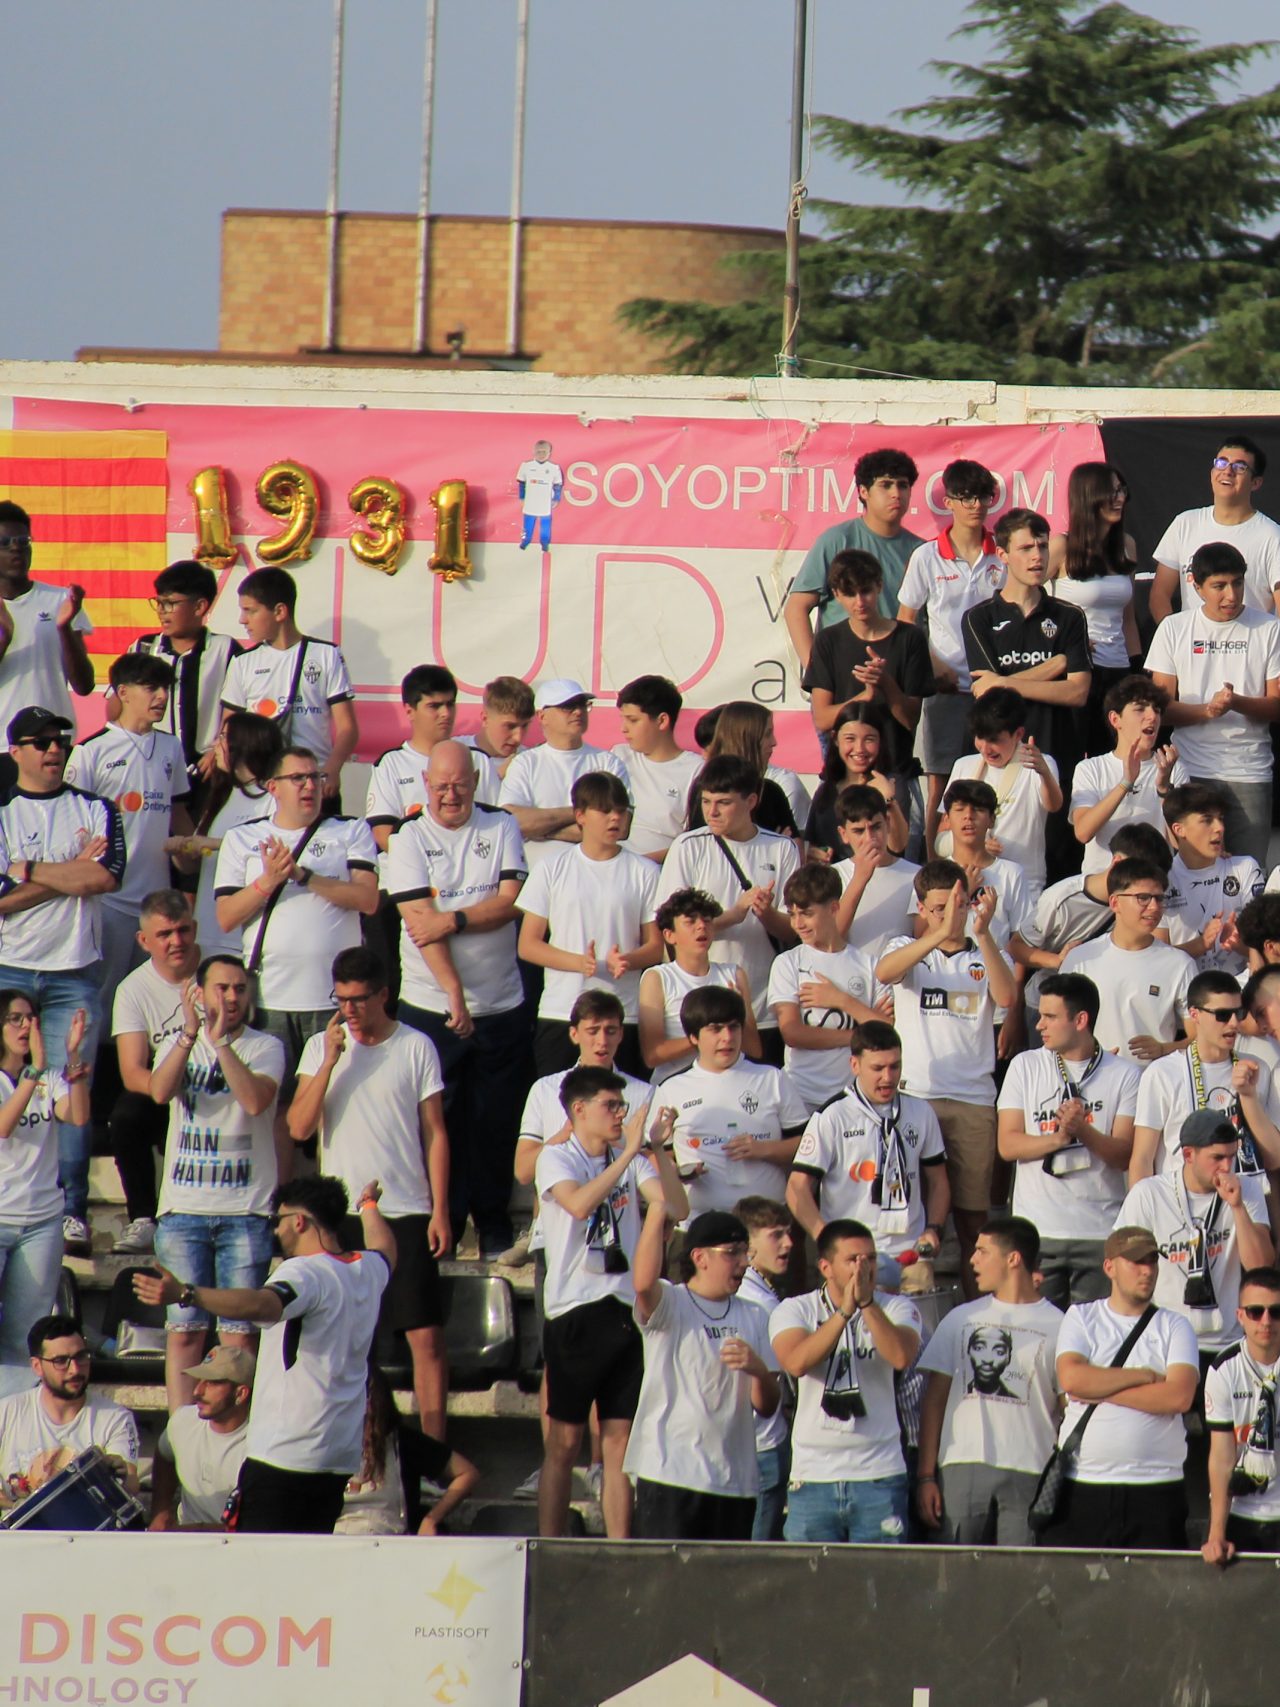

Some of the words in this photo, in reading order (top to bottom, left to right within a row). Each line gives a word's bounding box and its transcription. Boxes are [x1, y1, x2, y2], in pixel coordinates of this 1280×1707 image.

[187, 458, 474, 583] 1931
[1204, 640, 1248, 650] HILFIGER
[440, 889, 465, 898] Caixa
[924, 993, 944, 1007] TM
[179, 1125, 221, 1157] MAN
[172, 1157, 252, 1188] HATTAN
[19, 1612, 332, 1668] DISCOM
[414, 1626, 489, 1640] PLASTISOFT
